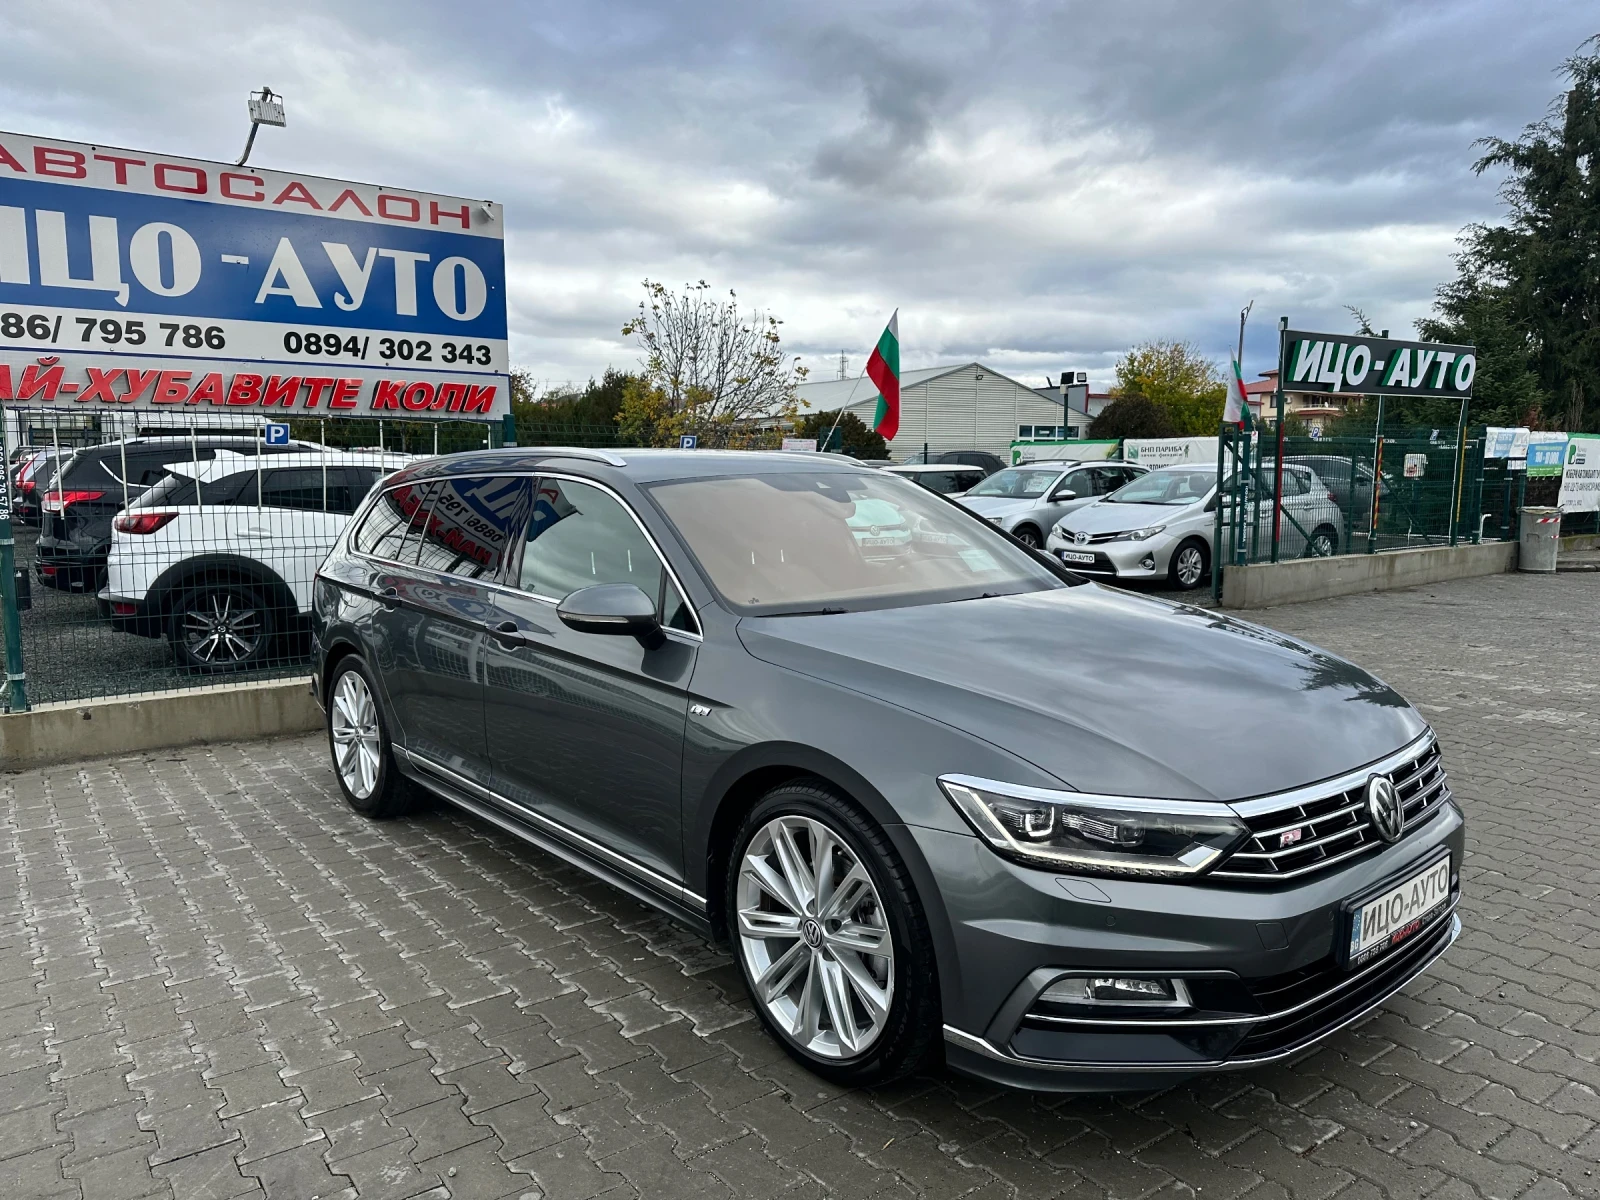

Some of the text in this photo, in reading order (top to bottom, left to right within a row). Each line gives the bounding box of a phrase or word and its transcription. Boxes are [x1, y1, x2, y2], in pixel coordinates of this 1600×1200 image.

[76, 317, 147, 346] 795
[159, 323, 225, 350] 786
[283, 331, 370, 360] 0894/
[379, 338, 432, 362] 302
[442, 342, 492, 365] 343
[1292, 339, 1476, 392] ИЦО-АУТО
[372, 379, 497, 413] КОЛИ
[270, 426, 285, 443] P
[1155, 445, 1182, 453] ПАРИБА
[1362, 863, 1448, 942] ИЦО-АУТО
[1350, 937, 1359, 952] BG
